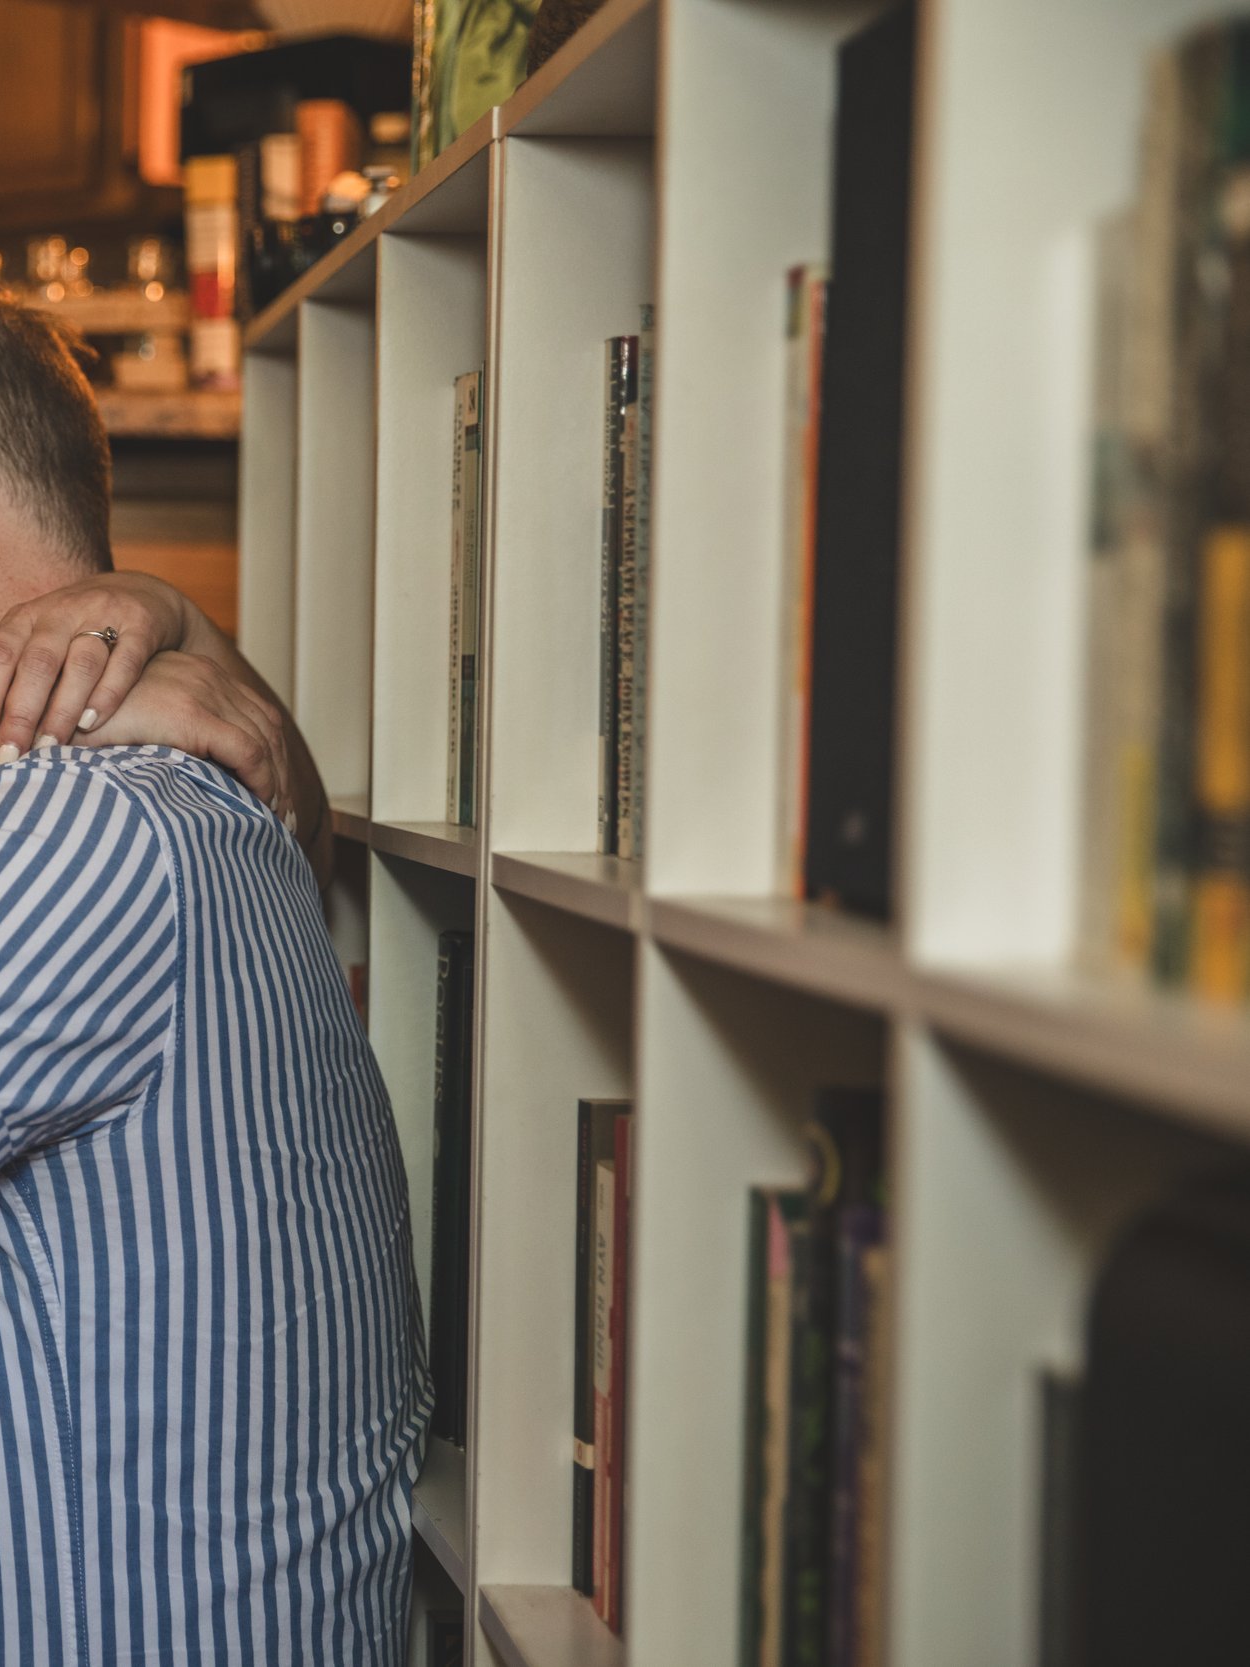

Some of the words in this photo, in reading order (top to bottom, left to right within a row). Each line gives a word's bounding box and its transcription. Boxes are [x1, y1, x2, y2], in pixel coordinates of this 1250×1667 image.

[621, 676, 634, 724] JOHN
[620, 731, 633, 818] KNOWLES
[598, 1232, 607, 1286] AYN
[596, 1294, 606, 1370] RAND
